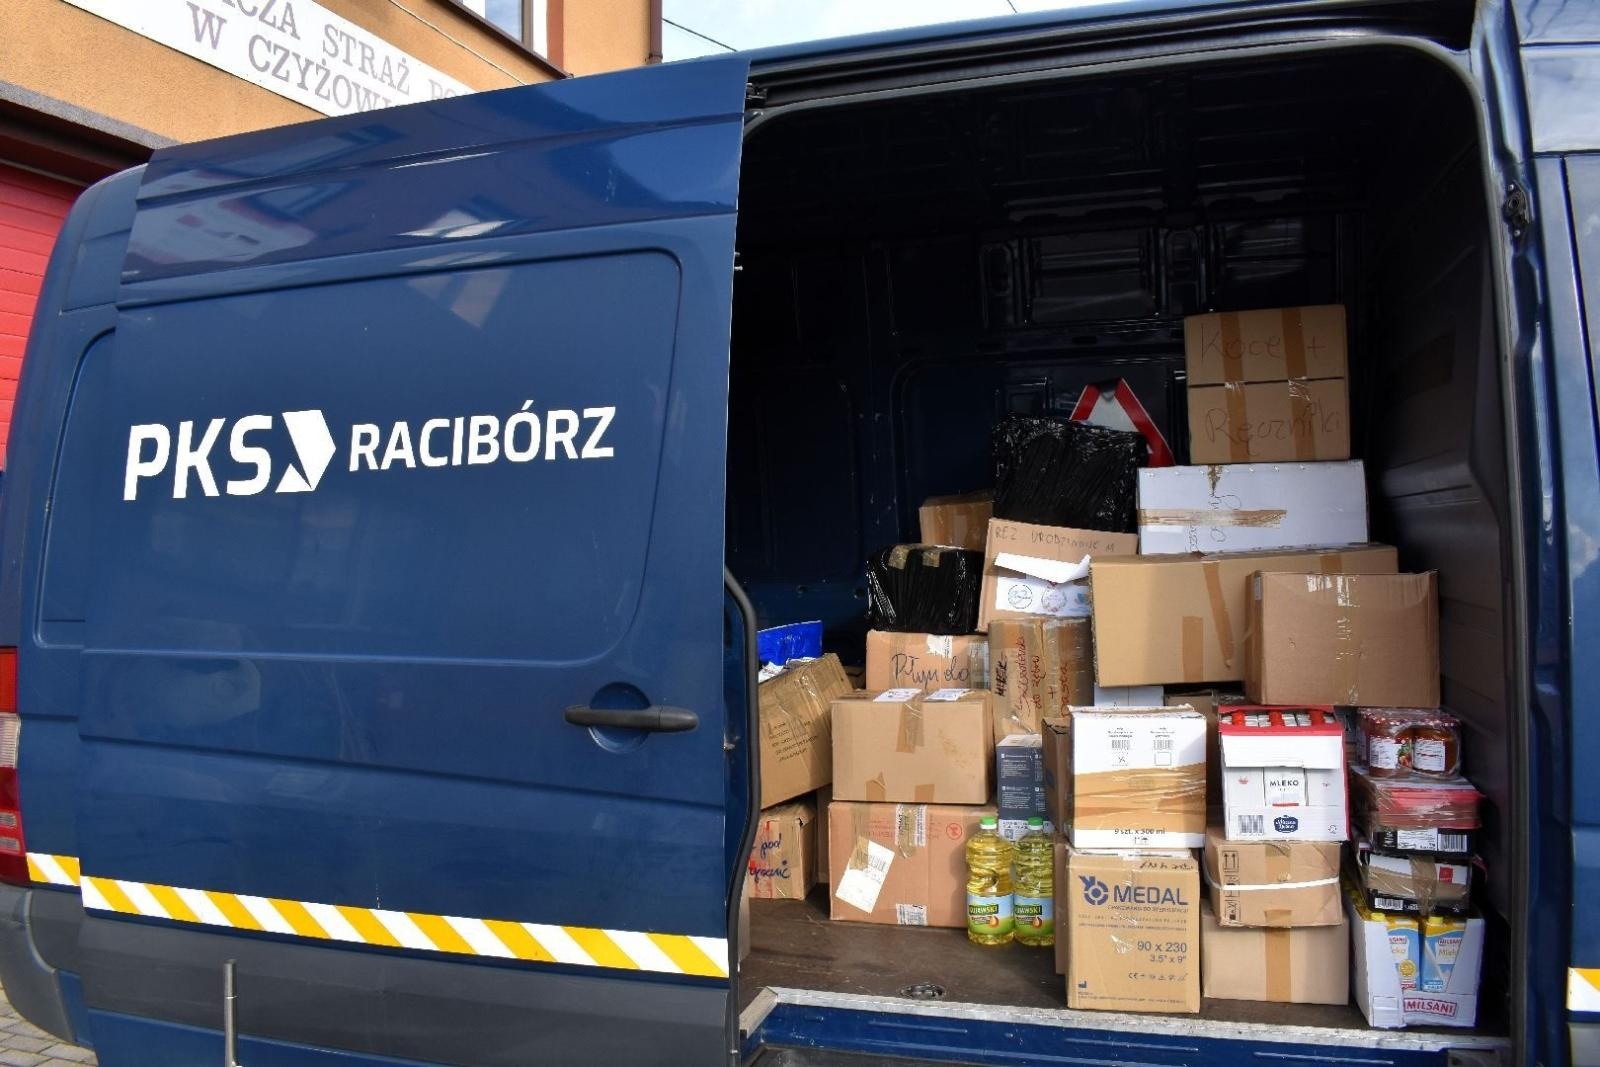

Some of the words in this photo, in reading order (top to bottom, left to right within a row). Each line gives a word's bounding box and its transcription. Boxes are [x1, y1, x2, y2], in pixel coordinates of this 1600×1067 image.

[186, 1, 227, 50] W
[322, 23, 411, 96] STRAŻ
[123, 413, 274, 501] PKS
[348, 399, 617, 472] RACIBÓRZ
[1269, 779, 1299, 787] MLEKO
[1113, 884, 1188, 905] MEDAL
[1137, 941, 1152, 951] 90
[1155, 943, 1162, 951] x
[1166, 942, 1187, 953] 230
[1406, 1000, 1454, 1016] MILSANI
